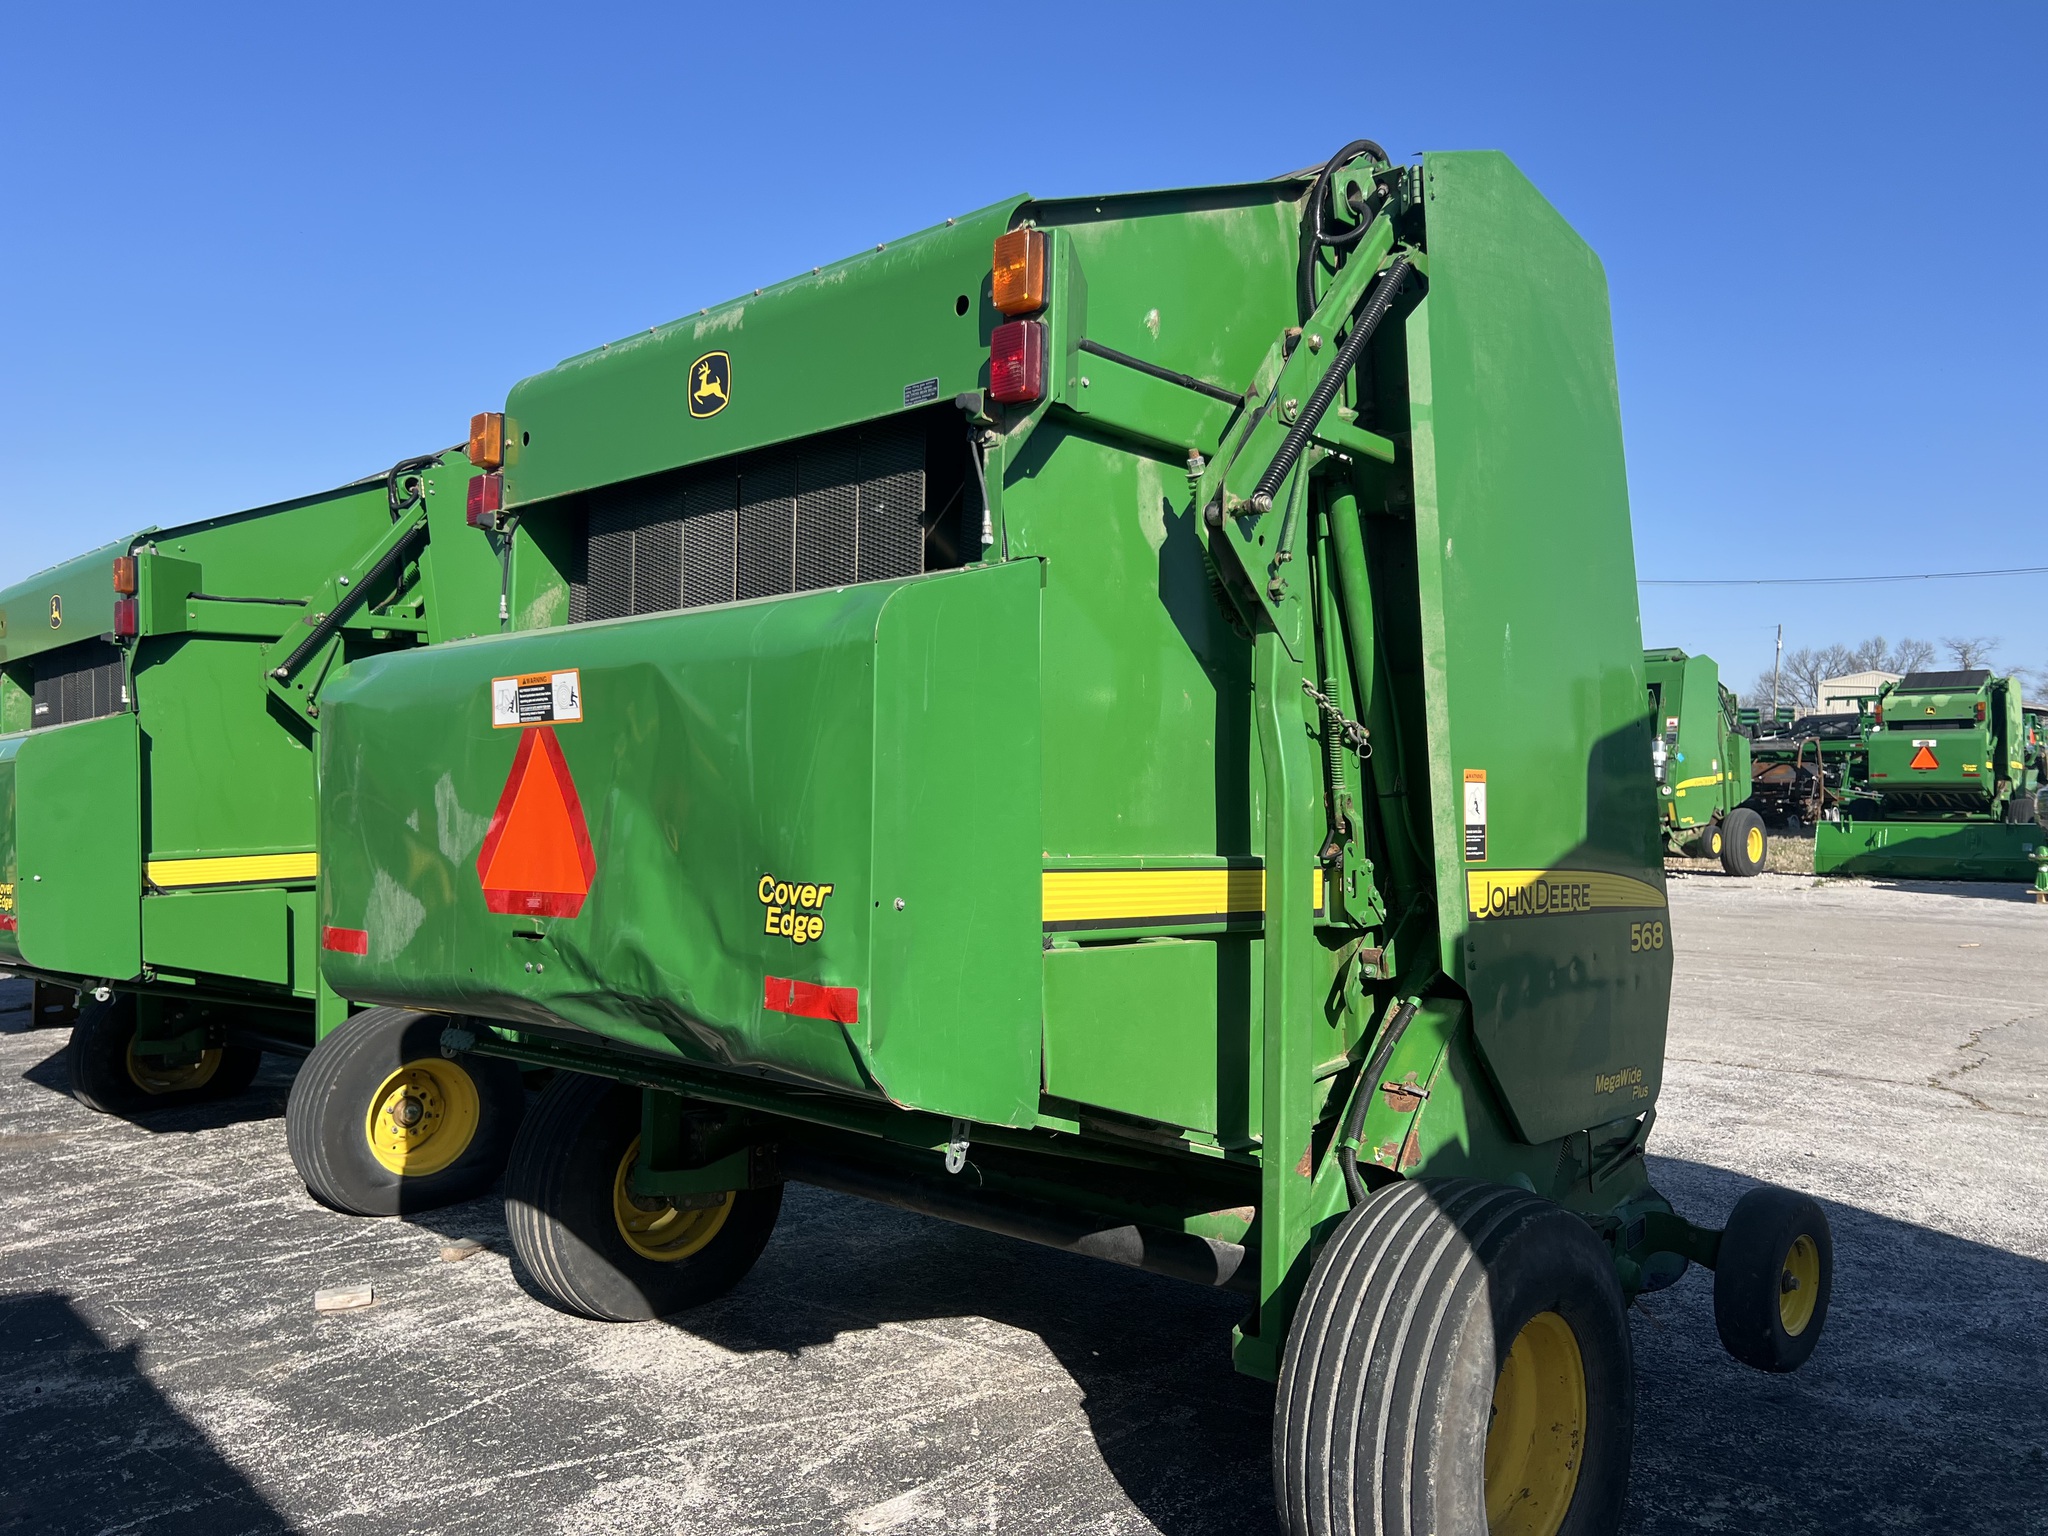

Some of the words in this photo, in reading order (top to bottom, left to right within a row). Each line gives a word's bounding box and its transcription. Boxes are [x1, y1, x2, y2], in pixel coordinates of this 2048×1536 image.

[0, 884, 14, 895] over
[758, 874, 833, 909] Cover
[1478, 881, 1533, 916] JOHN
[1535, 879, 1591, 913] DEERE
[765, 906, 824, 944] Edge
[1631, 921, 1664, 952] 568
[1595, 1066, 1642, 1094] MegaWide
[1632, 1085, 1649, 1101] Plus
